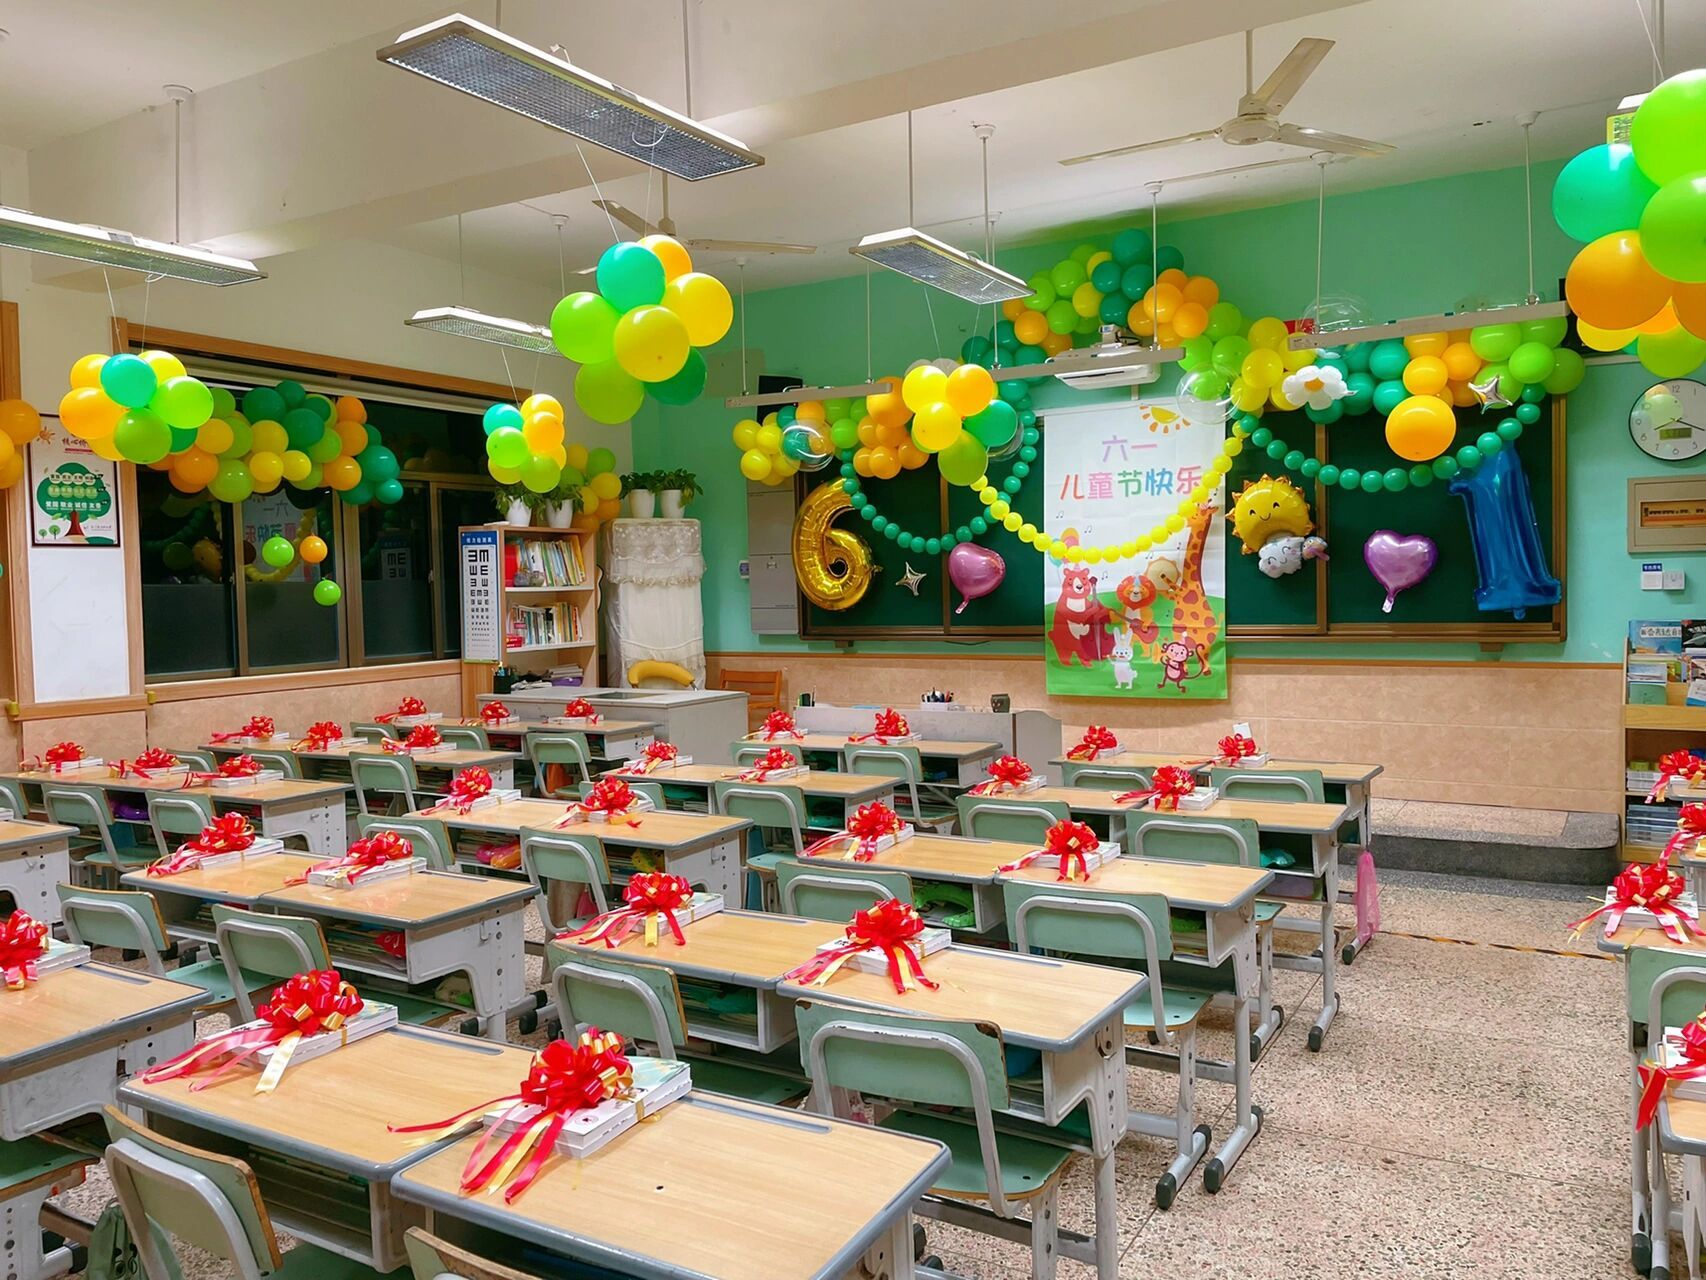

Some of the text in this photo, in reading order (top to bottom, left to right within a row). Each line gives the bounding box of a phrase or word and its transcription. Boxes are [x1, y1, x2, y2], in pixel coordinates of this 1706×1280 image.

[1101, 434, 1158, 462] 六一
[1059, 465, 1203, 500] 儿童节快乐
[792, 476, 873, 612] 6
